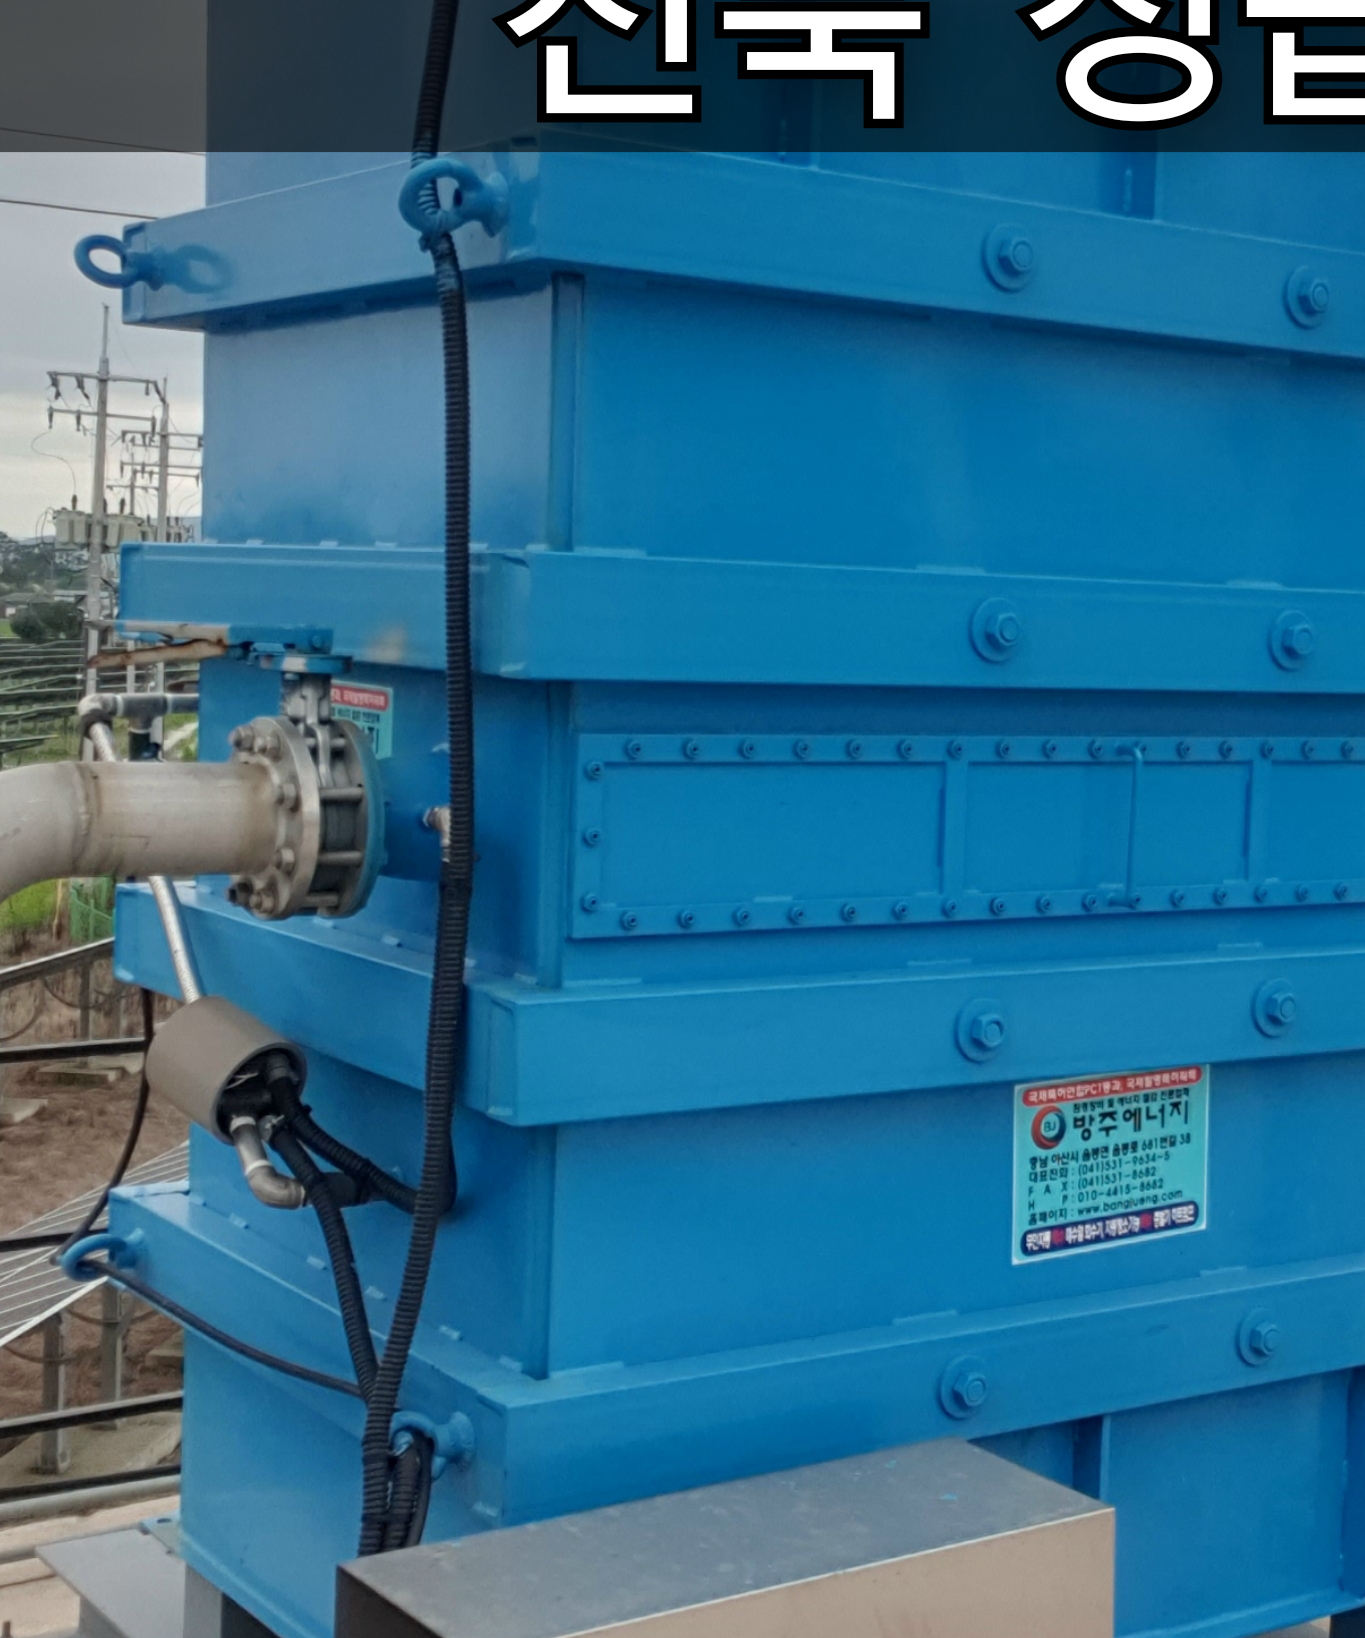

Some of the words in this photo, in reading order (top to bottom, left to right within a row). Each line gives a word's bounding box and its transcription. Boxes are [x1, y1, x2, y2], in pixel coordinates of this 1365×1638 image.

[1072, 1100, 1189, 1141] 방주에너지
[1051, 1152, 1079, 1166] 아산시
[1179, 1132, 1192, 1145] 38
